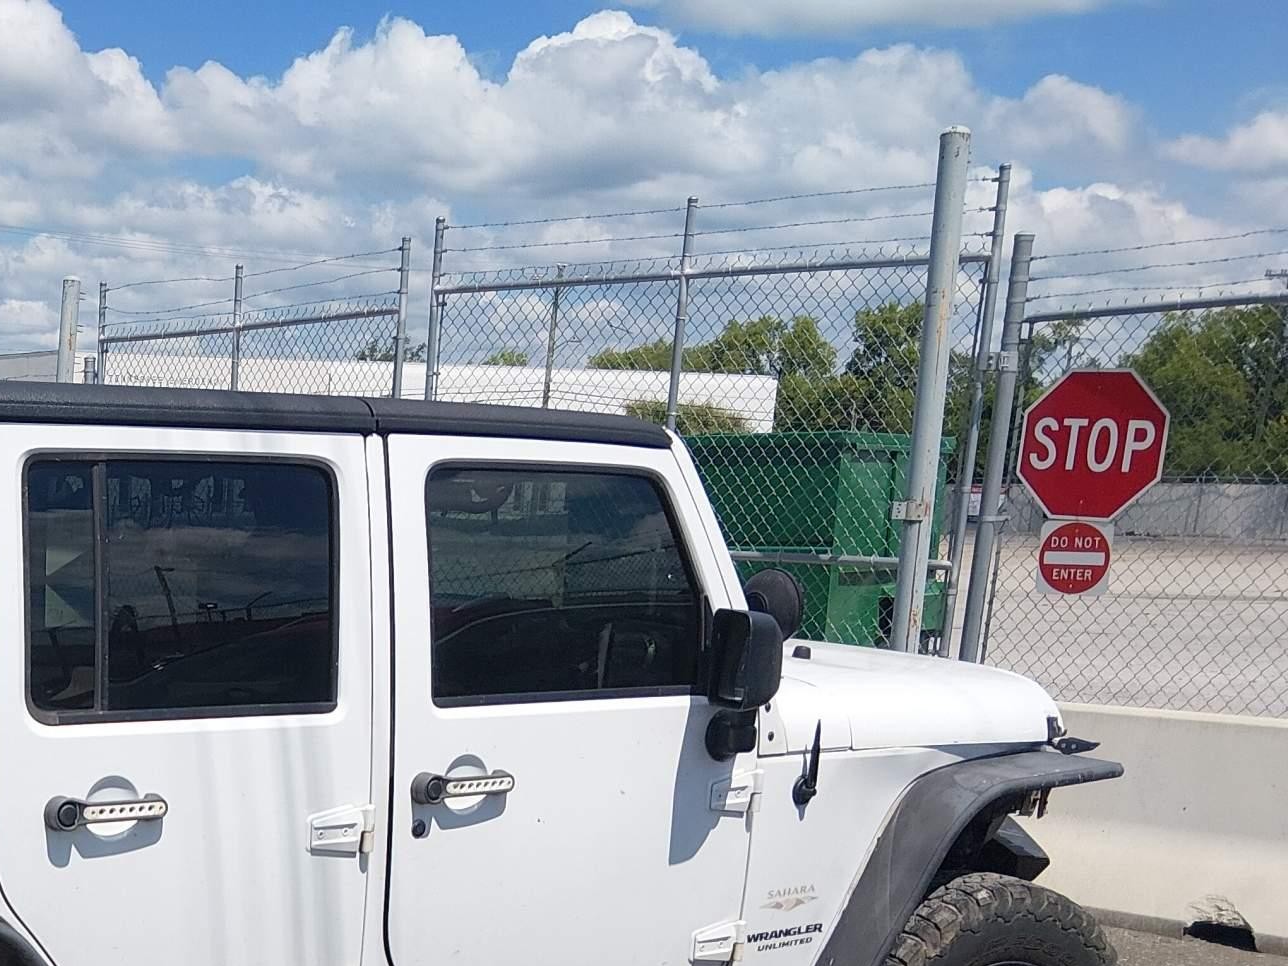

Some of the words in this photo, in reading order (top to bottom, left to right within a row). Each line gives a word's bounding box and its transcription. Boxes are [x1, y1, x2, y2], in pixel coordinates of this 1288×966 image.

[1029, 417, 1156, 473] STOP
[1051, 537, 1069, 549] DO
[1074, 537, 1101, 549] NOT
[1052, 569, 1092, 581] ENTER
[767, 884, 816, 900] SAHARA
[746, 923, 823, 944] WRANGLER
[757, 937, 813, 952] UNLIMITED
